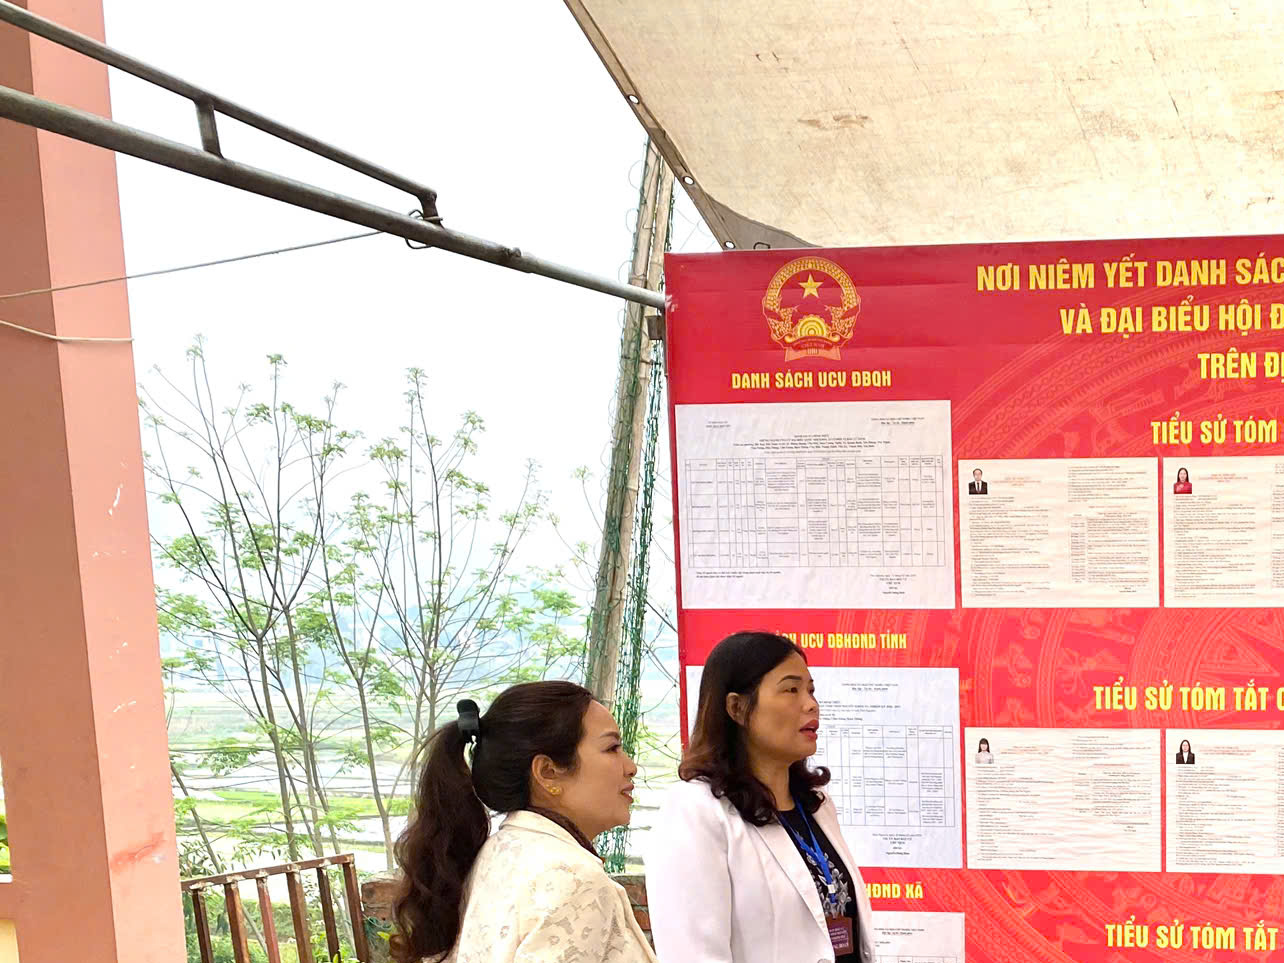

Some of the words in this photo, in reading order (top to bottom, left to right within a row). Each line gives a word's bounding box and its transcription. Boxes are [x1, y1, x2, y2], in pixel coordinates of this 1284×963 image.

[977, 263, 1020, 291] NƠI
[1029, 257, 1095, 290] NIÊM
[1103, 251, 1148, 288] YẾT
[1156, 259, 1226, 287] DANH
[1059, 300, 1093, 335] VÀ
[1099, 306, 1143, 339] ĐẠI
[1151, 295, 1210, 332] BIỂU
[1218, 298, 1261, 337] HỘI
[731, 372, 770, 389] DANH
[775, 368, 813, 388] SÁCH
[818, 371, 847, 388] UCV
[851, 370, 891, 387] ĐBQH
[1197, 346, 1257, 380] TRÊN
[1151, 410, 1193, 445] TIỂU
[1200, 411, 1228, 445] SỬ
[1233, 413, 1278, 444] TÓM
[800, 633, 824, 649] UCV
[827, 633, 877, 649] ĐBHĐND
[880, 629, 907, 649] TỈNH
[1093, 675, 1138, 711] TIỂU
[1144, 679, 1174, 712] SỬ
[1179, 682, 1226, 711] TÓM
[1233, 679, 1269, 712] TẮT
[863, 882, 901, 899] HĐND
[905, 880, 924, 899] XÃ
[1105, 914, 1149, 948] TIỂU
[1156, 918, 1185, 949] SỬ
[1190, 921, 1236, 950] TÓM
[1243, 919, 1279, 951] TẮT
